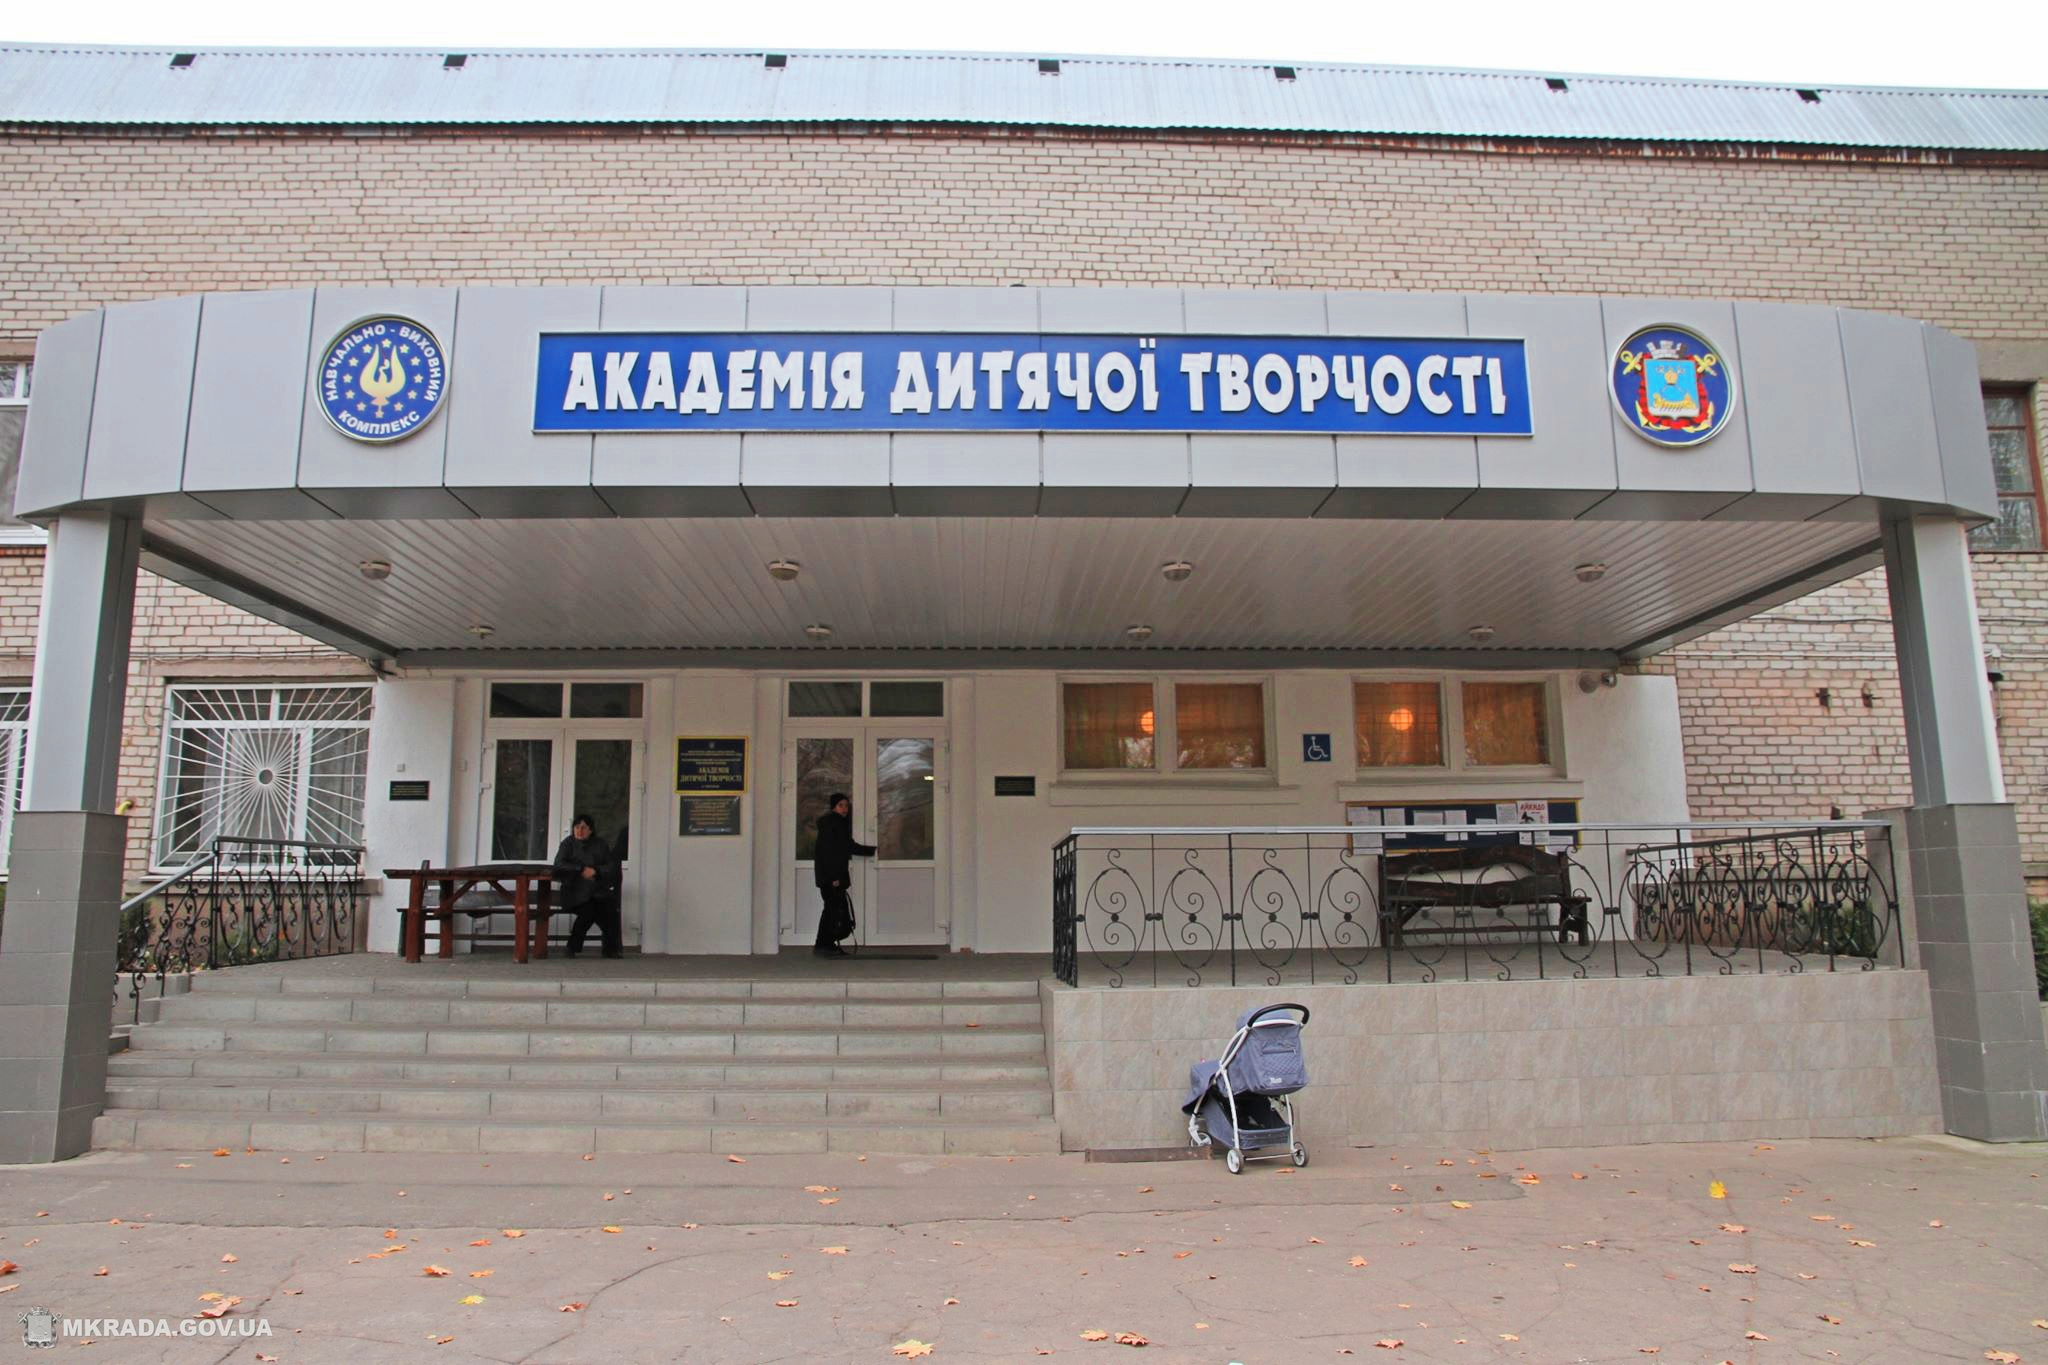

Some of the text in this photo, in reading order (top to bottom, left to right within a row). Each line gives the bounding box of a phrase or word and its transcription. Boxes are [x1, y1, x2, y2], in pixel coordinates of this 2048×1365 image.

[325, 324, 386, 401] НАВЧАЛЬНО
[399, 326, 441, 402] ВИХОВНИЙ
[562, 338, 1507, 415] АКАДЕМІЯ ДИТЯЧОЇ ТВОРЧОСТІ
[338, 410, 420, 434] КОМПЛЕКС
